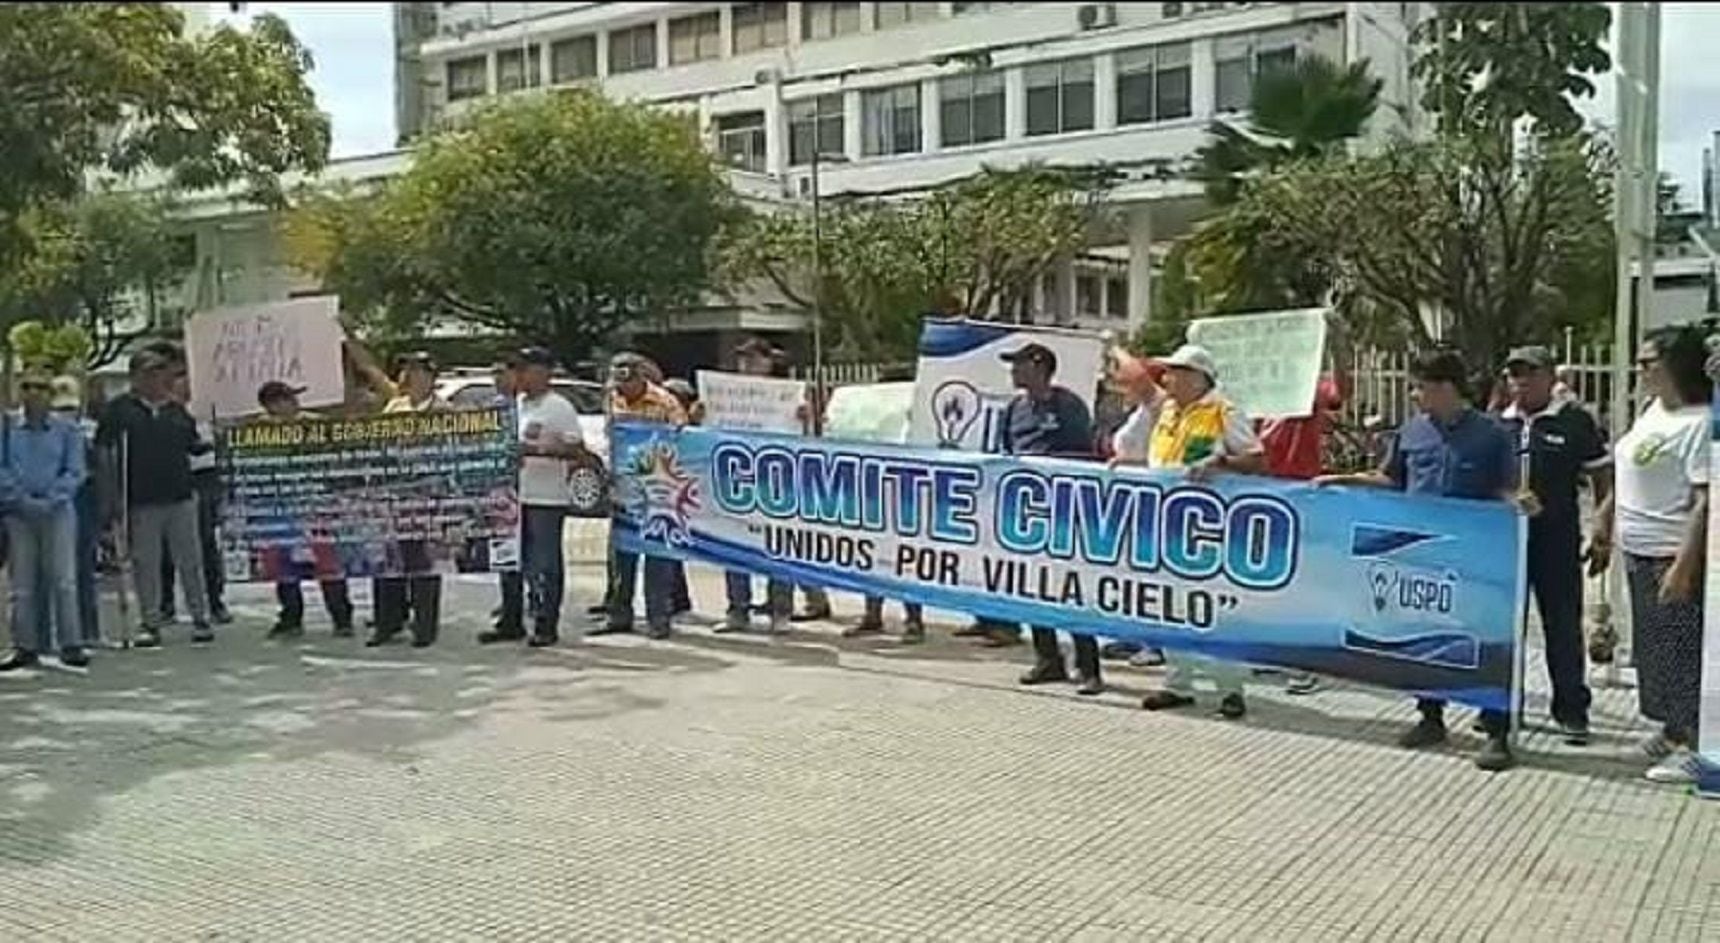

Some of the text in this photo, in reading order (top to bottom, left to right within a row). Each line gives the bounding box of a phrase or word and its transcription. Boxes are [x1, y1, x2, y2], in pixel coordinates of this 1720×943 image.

[226, 424, 303, 447] LLAMADO
[306, 422, 328, 442] AL
[419, 409, 501, 434] NACIONAL
[712, 441, 1297, 590] COMITE CIVICO
[896, 543, 960, 586] POR
[983, 556, 1083, 607] VILLA
